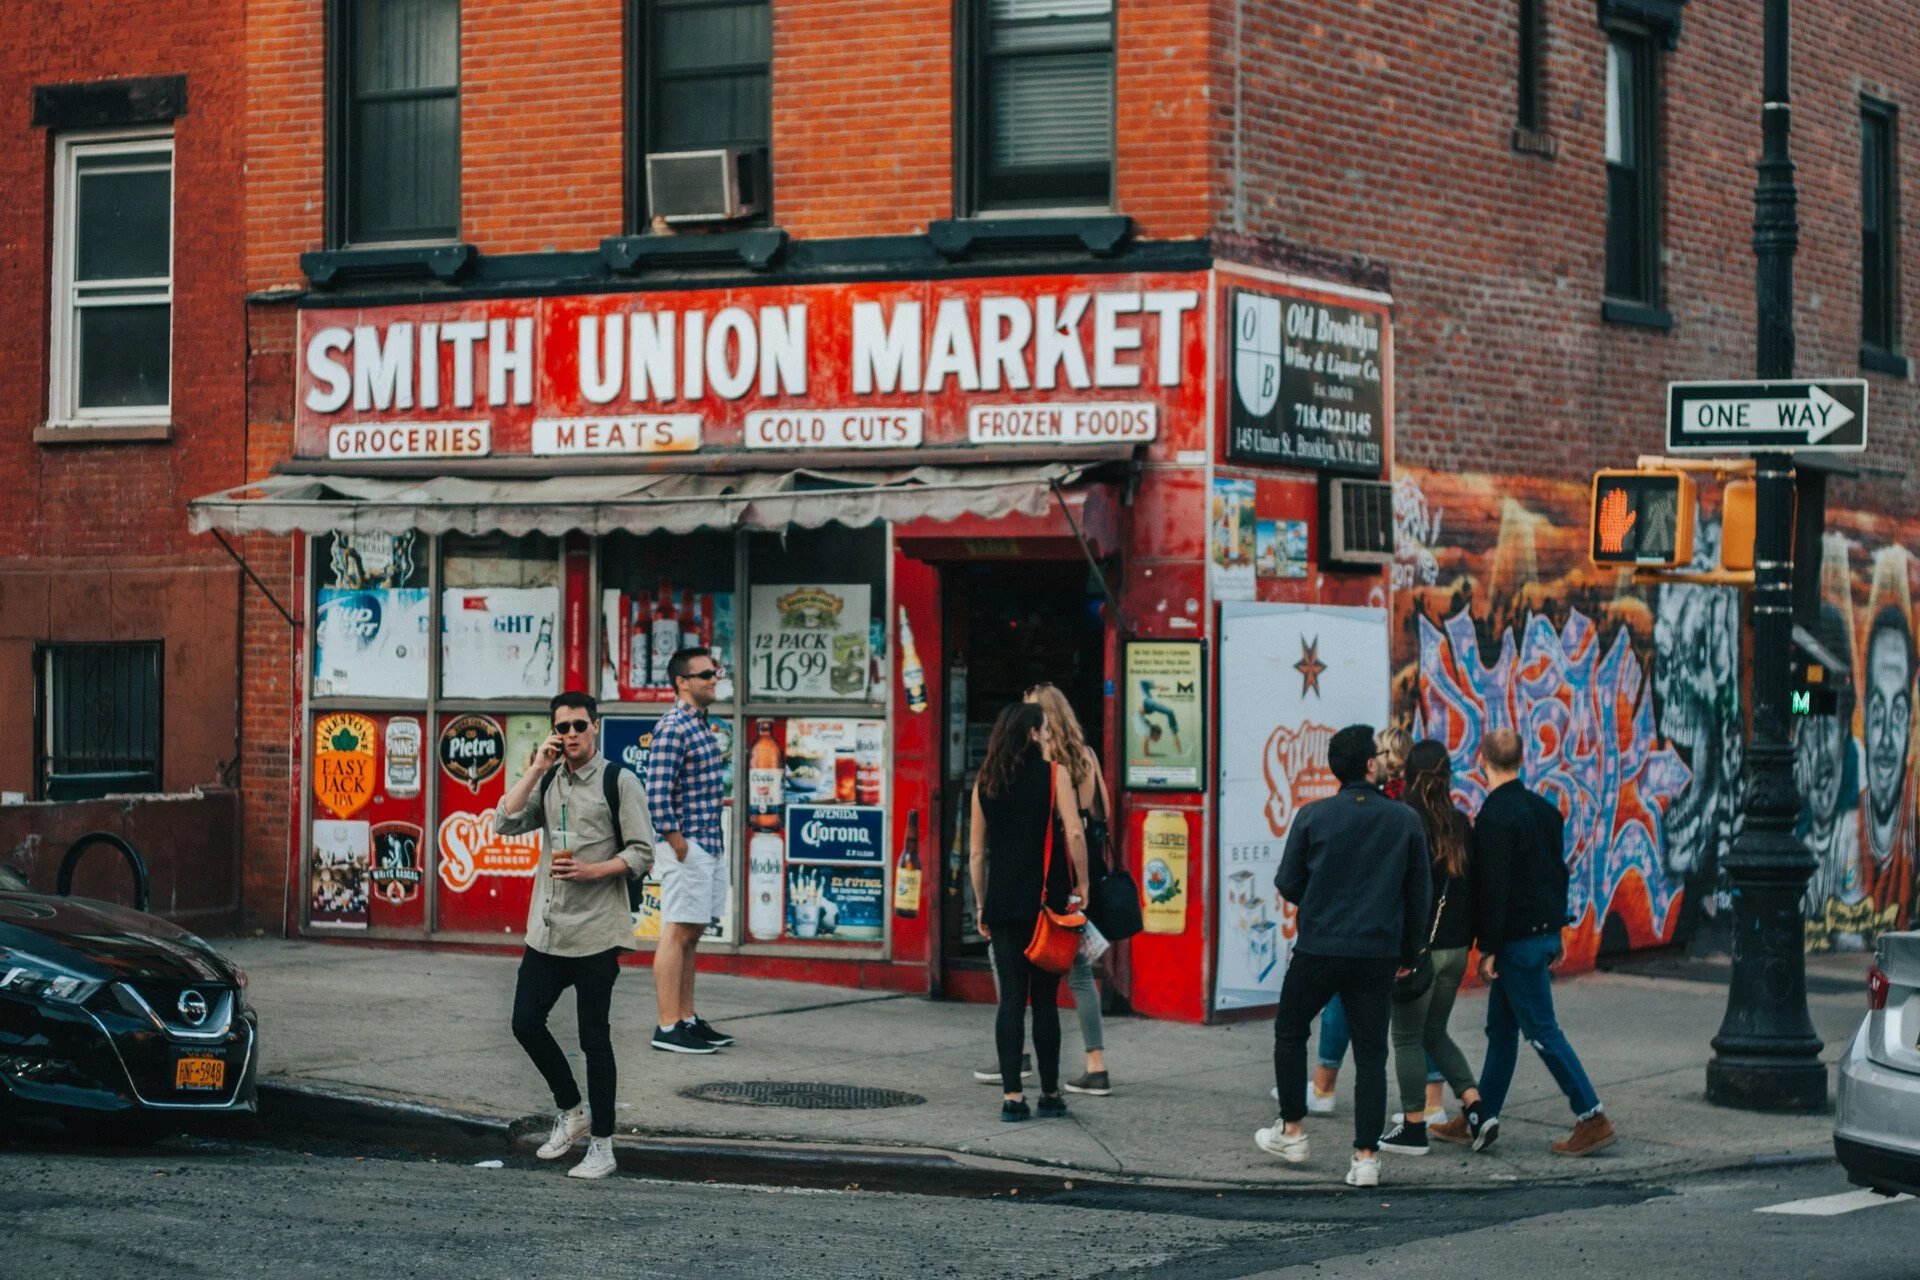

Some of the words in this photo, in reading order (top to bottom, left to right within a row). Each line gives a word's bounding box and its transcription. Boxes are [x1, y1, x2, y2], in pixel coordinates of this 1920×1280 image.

[1242, 306, 1257, 341] O
[1286, 303, 1315, 341] Old
[1316, 309, 1379, 358] Brooklyn
[306, 317, 534, 413] SMITH
[579, 303, 807, 404] UNION
[852, 291, 1198, 394] MARKET
[1284, 346, 1311, 371] Wine
[1313, 352, 1324, 372] &
[1326, 352, 1361, 380] Liquor
[1262, 364, 1275, 398] B
[978, 411, 1062, 437] FROZEN
[1076, 409, 1149, 435] FOODS
[1698, 403, 1750, 428] ONE
[1777, 402, 1832, 428] WAY
[336, 427, 482, 453] GROCERIES
[556, 422, 674, 448] MEATS
[760, 417, 825, 442] COLD
[843, 416, 908, 441] CUTS
[1254, 428, 1280, 453] Union
[755, 633, 773, 649] 12
[777, 632, 829, 650] PACK
[322, 713, 368, 751] FIRESTONE
[449, 737, 496, 759] Pietra
[622, 745, 651, 765] Cor
[323, 758, 366, 776] EASY
[322, 775, 365, 795] JACK
[334, 794, 353, 806] IPA
[813, 809, 859, 820] AVENIDA
[801, 820, 871, 848] Corona
[483, 854, 532, 866] BREWERY
[1232, 845, 1270, 861] BEER
[373, 869, 395, 880] WHITE
[831, 877, 843, 887] EL
[200, 1062, 222, 1082] 5948
